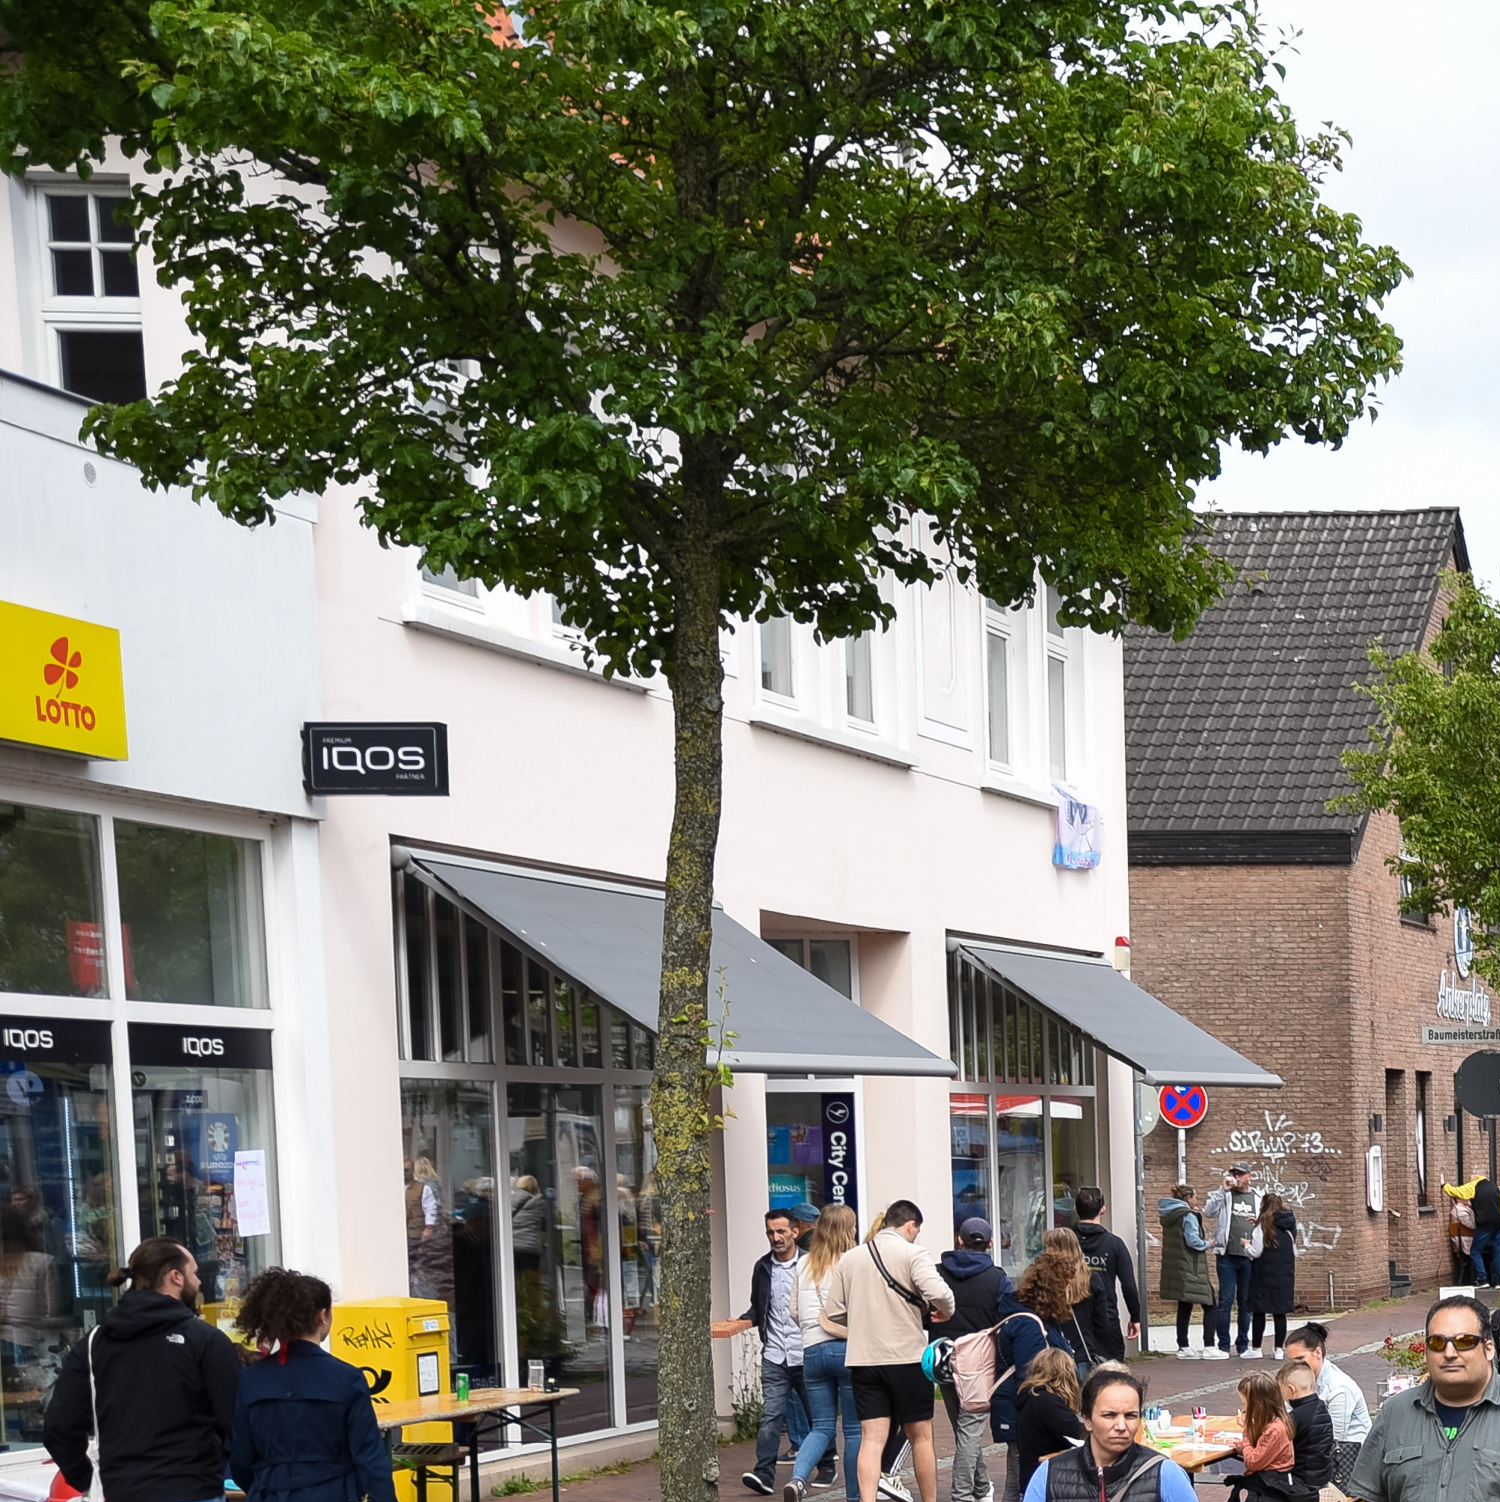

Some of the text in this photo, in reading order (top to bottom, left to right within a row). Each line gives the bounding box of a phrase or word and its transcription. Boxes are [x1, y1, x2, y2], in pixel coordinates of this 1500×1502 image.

[35, 695, 96, 731] LOTTO
[322, 746, 425, 774] IQOS
[3, 1028, 54, 1050] IQOS
[182, 1037, 225, 1057] IQOS
[828, 1131, 849, 1206] City Cen
[768, 1182, 801, 1193] diosus
